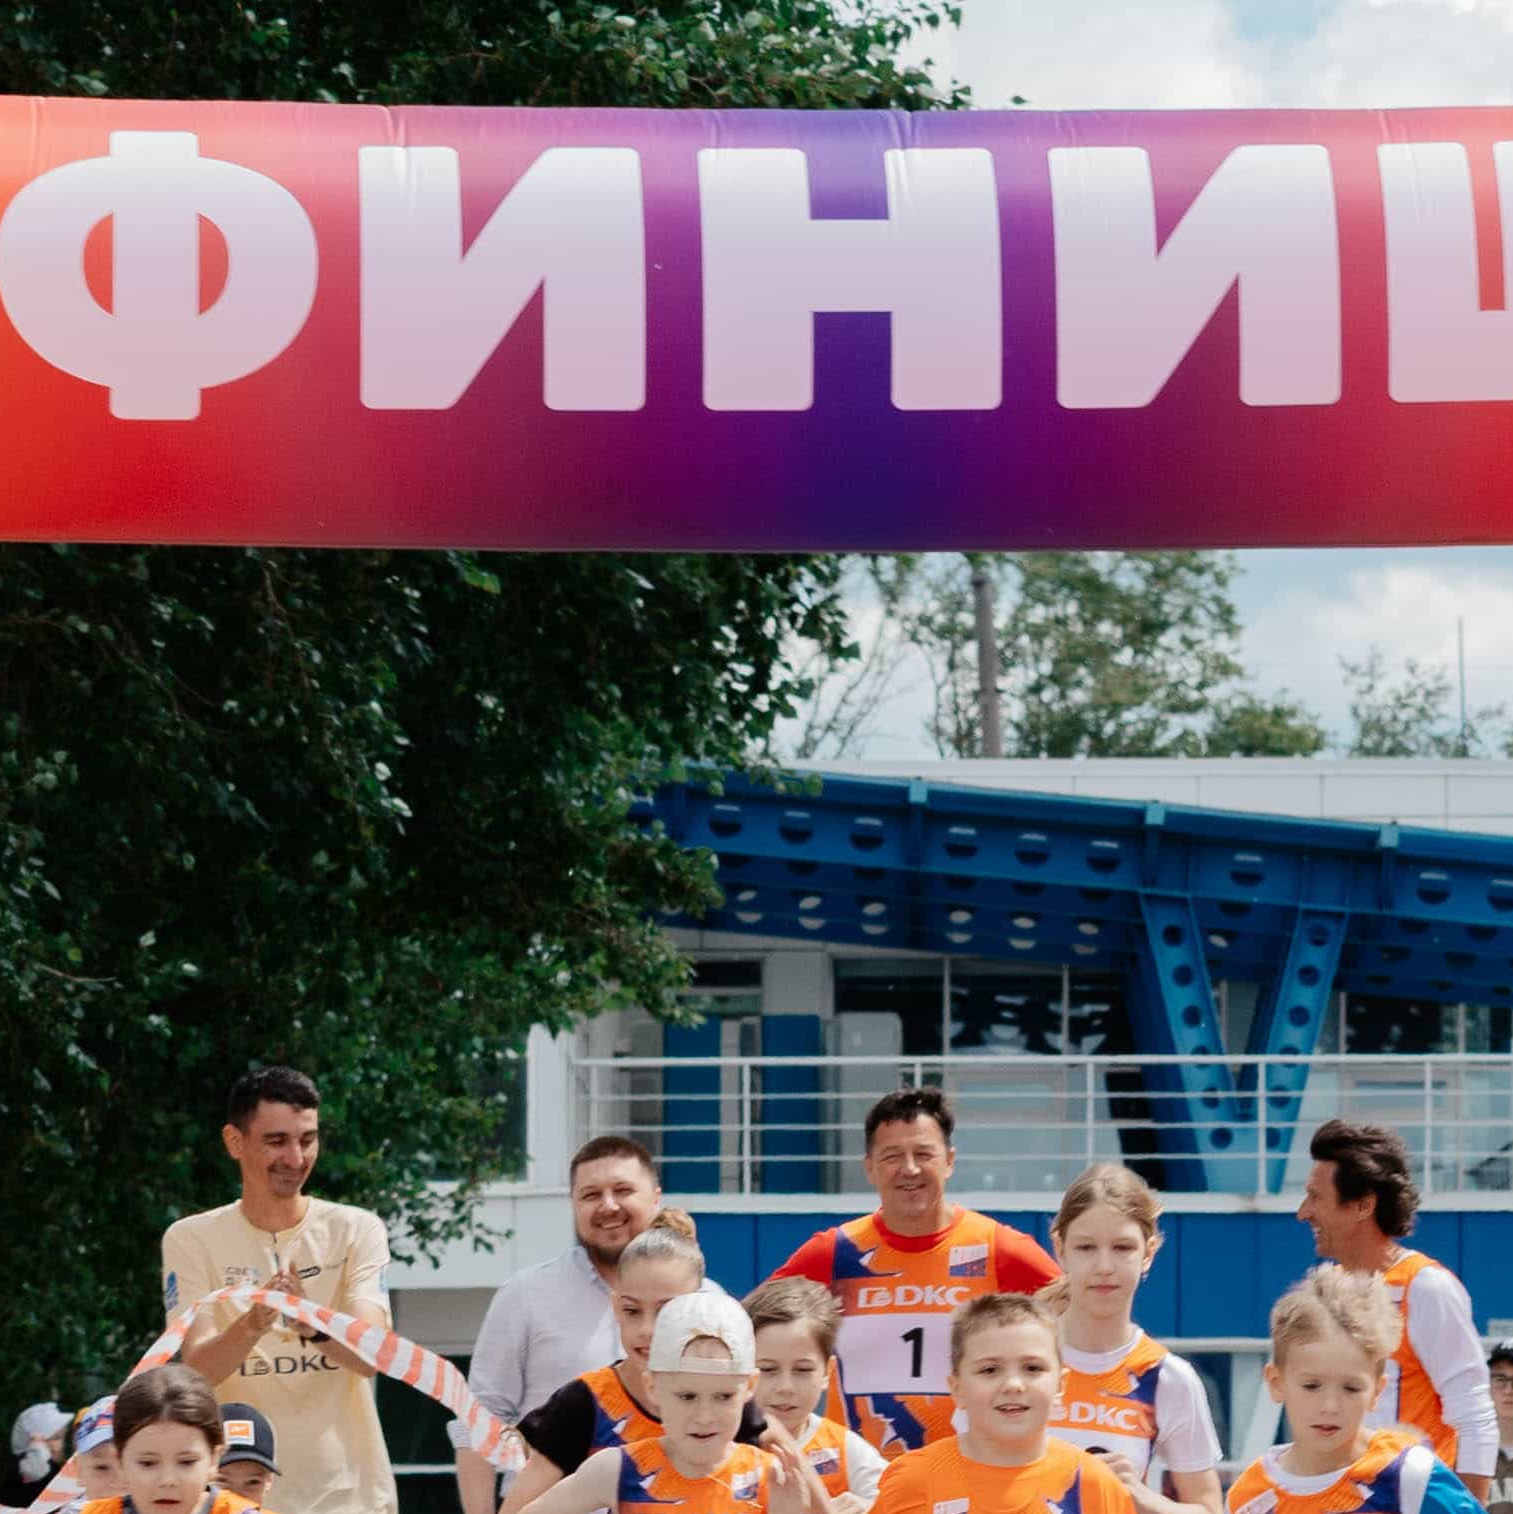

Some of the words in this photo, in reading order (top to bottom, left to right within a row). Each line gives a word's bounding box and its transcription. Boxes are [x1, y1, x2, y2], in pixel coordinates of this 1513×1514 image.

[895, 1284, 972, 1307] DKC
[901, 1327, 924, 1378] 1
[1070, 1401, 1139, 1430] DKC
